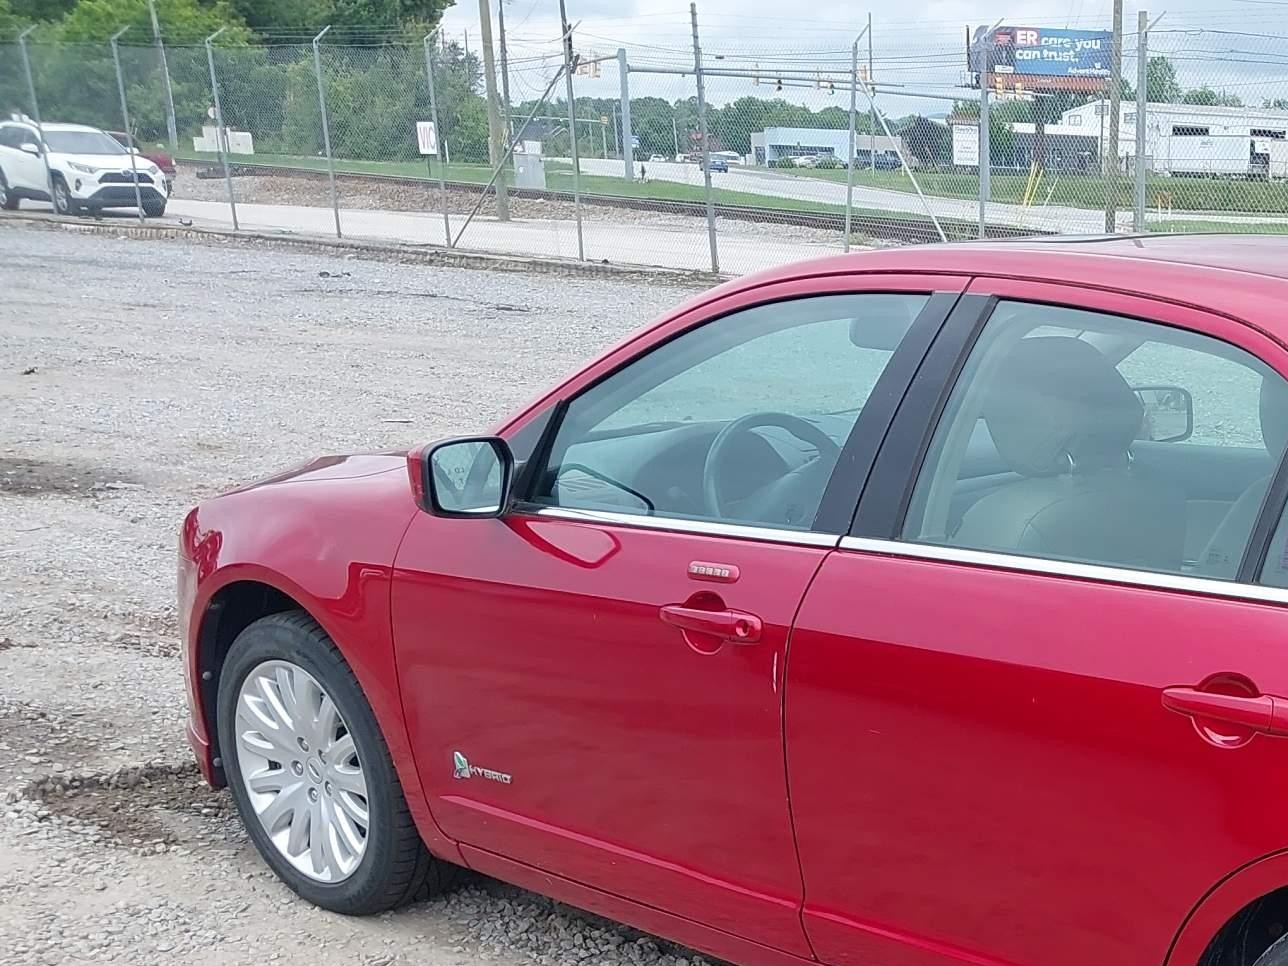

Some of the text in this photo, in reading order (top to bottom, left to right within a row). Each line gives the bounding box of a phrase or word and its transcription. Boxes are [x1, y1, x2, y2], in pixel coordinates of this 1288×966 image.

[1016, 30, 1101, 52] ER care you
[1015, 49, 1078, 63] can trust.
[468, 765, 512, 784] HYBRID
